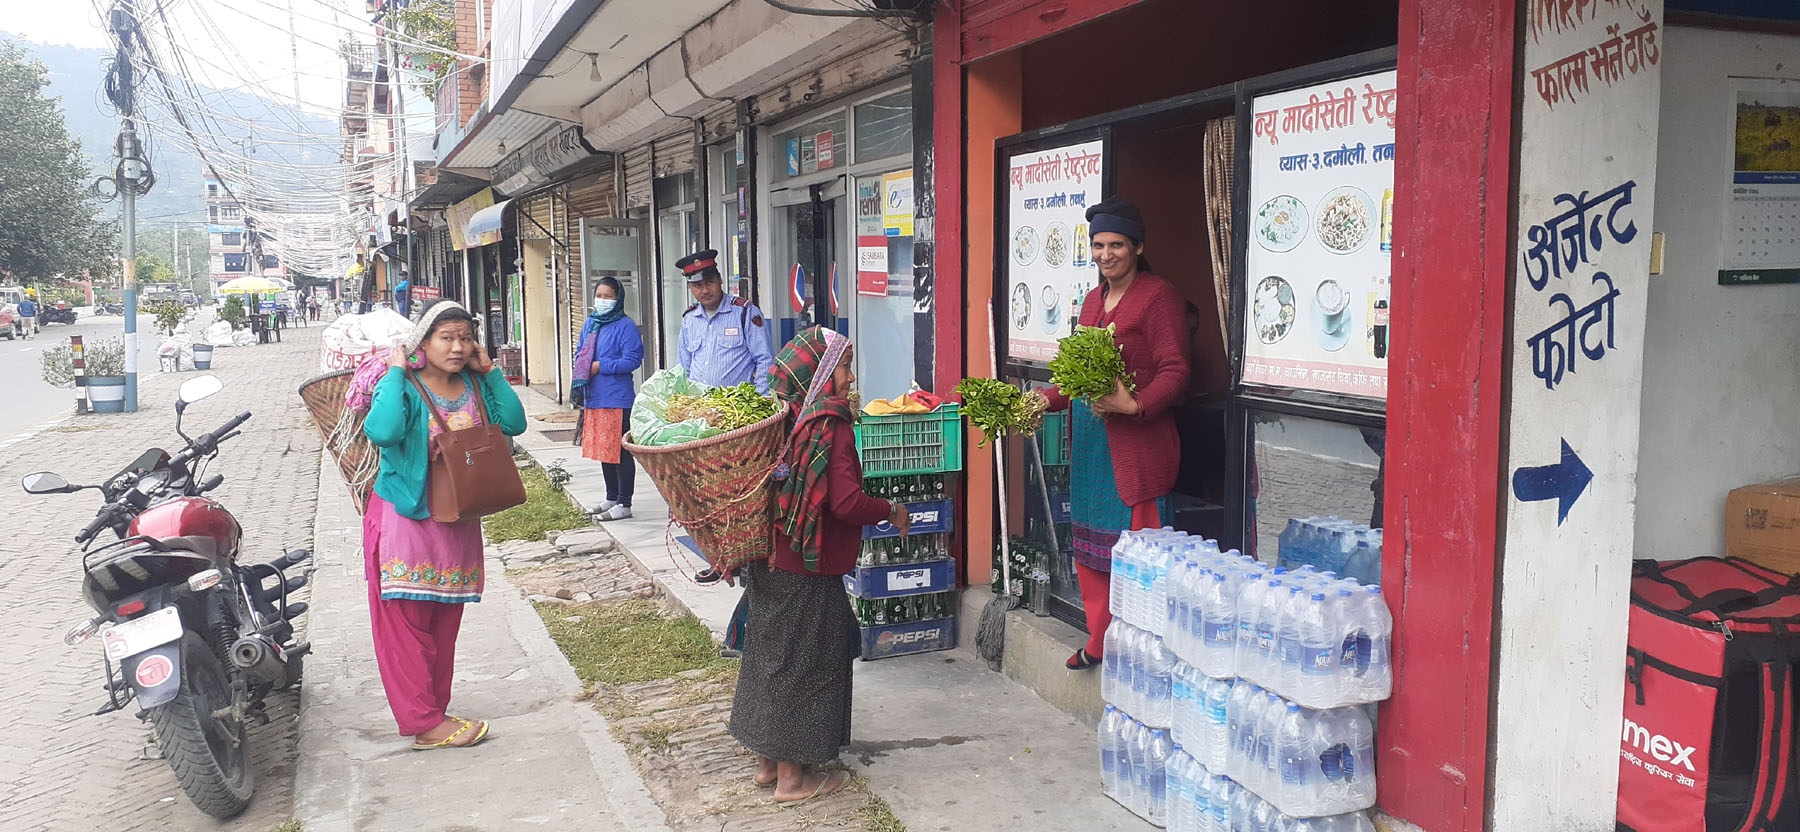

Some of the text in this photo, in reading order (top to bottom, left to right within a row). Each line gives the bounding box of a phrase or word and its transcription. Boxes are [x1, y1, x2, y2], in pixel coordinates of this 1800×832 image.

[1531, 51, 1590, 111] फारम
[1255, 83, 1397, 145] न्यू मादीसेती रेष्टु
[1373, 143, 1395, 163] तन
[1011, 166, 1024, 191] न्यू
[1025, 154, 1062, 184] मादीसेती
[1526, 271, 1620, 391] फोटो
[909, 510, 939, 523] PSI
[896, 570, 924, 580] PEPSI
[893, 628, 941, 645] PEPSI
[1622, 718, 1697, 772] mex
[1675, 773, 1695, 788] सेवा
